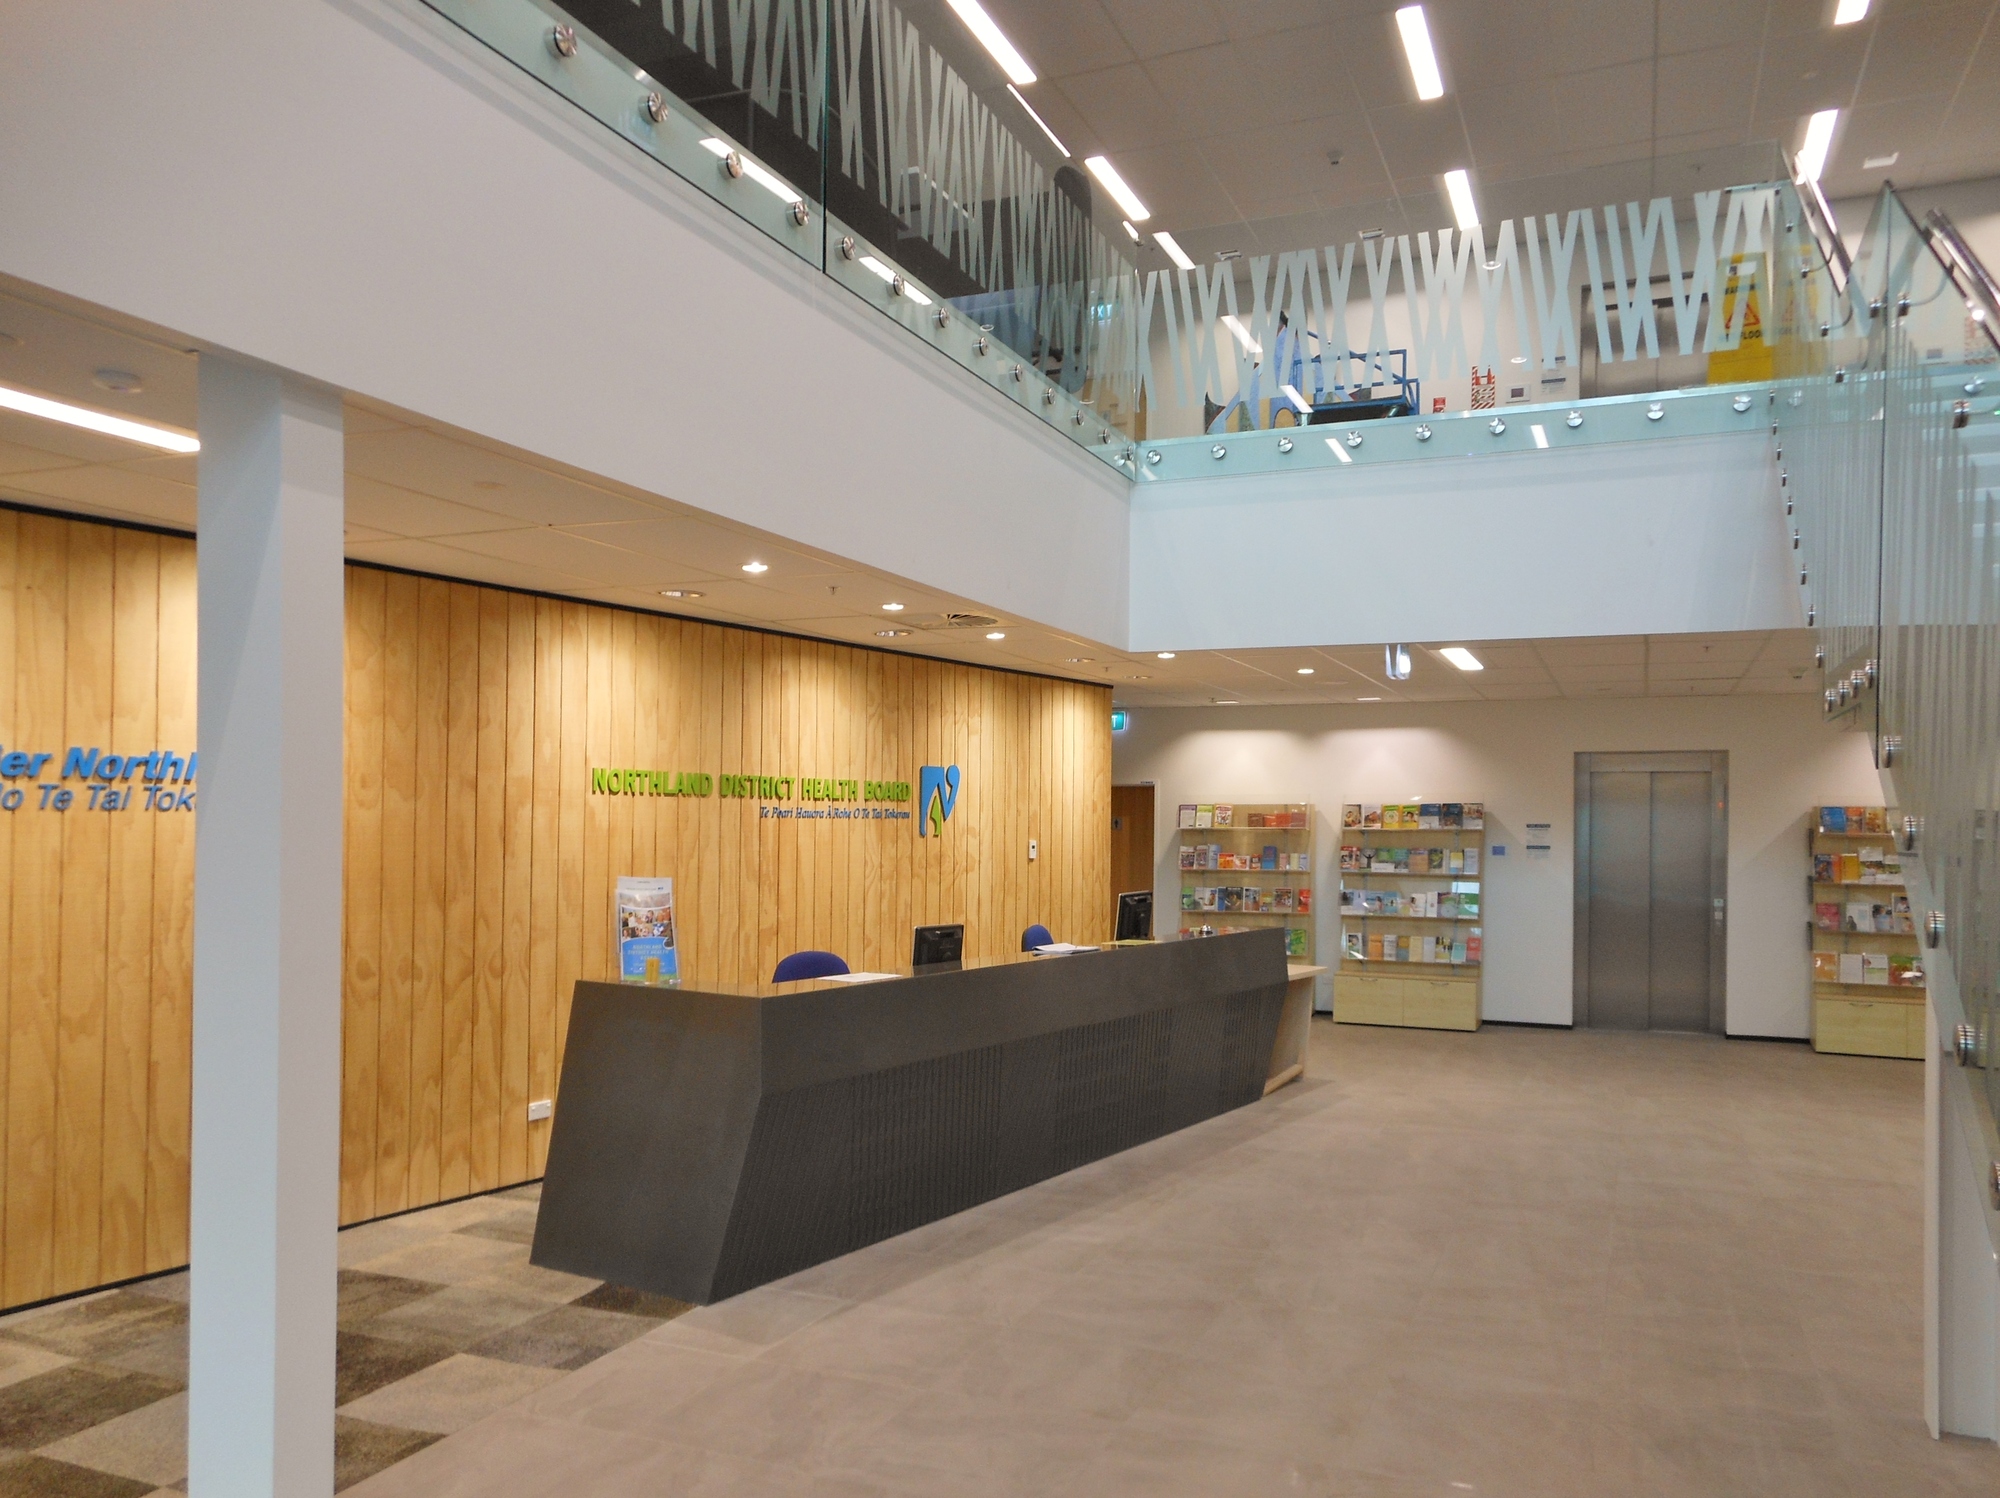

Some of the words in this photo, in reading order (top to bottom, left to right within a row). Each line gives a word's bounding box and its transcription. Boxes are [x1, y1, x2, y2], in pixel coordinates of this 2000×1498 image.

[0, 745, 53, 778] er
[39, 784, 73, 811] Te
[87, 785, 132, 812] Tai
[592, 768, 713, 797] NORTHLAND
[719, 775, 796, 800] DISTRICT
[802, 778, 858, 801] HEALTH
[864, 781, 912, 802] BOARD
[760, 806, 769, 818] Te
[854, 808, 860, 819] O
[862, 808, 870, 819] Te
[873, 808, 883, 819] Tai
